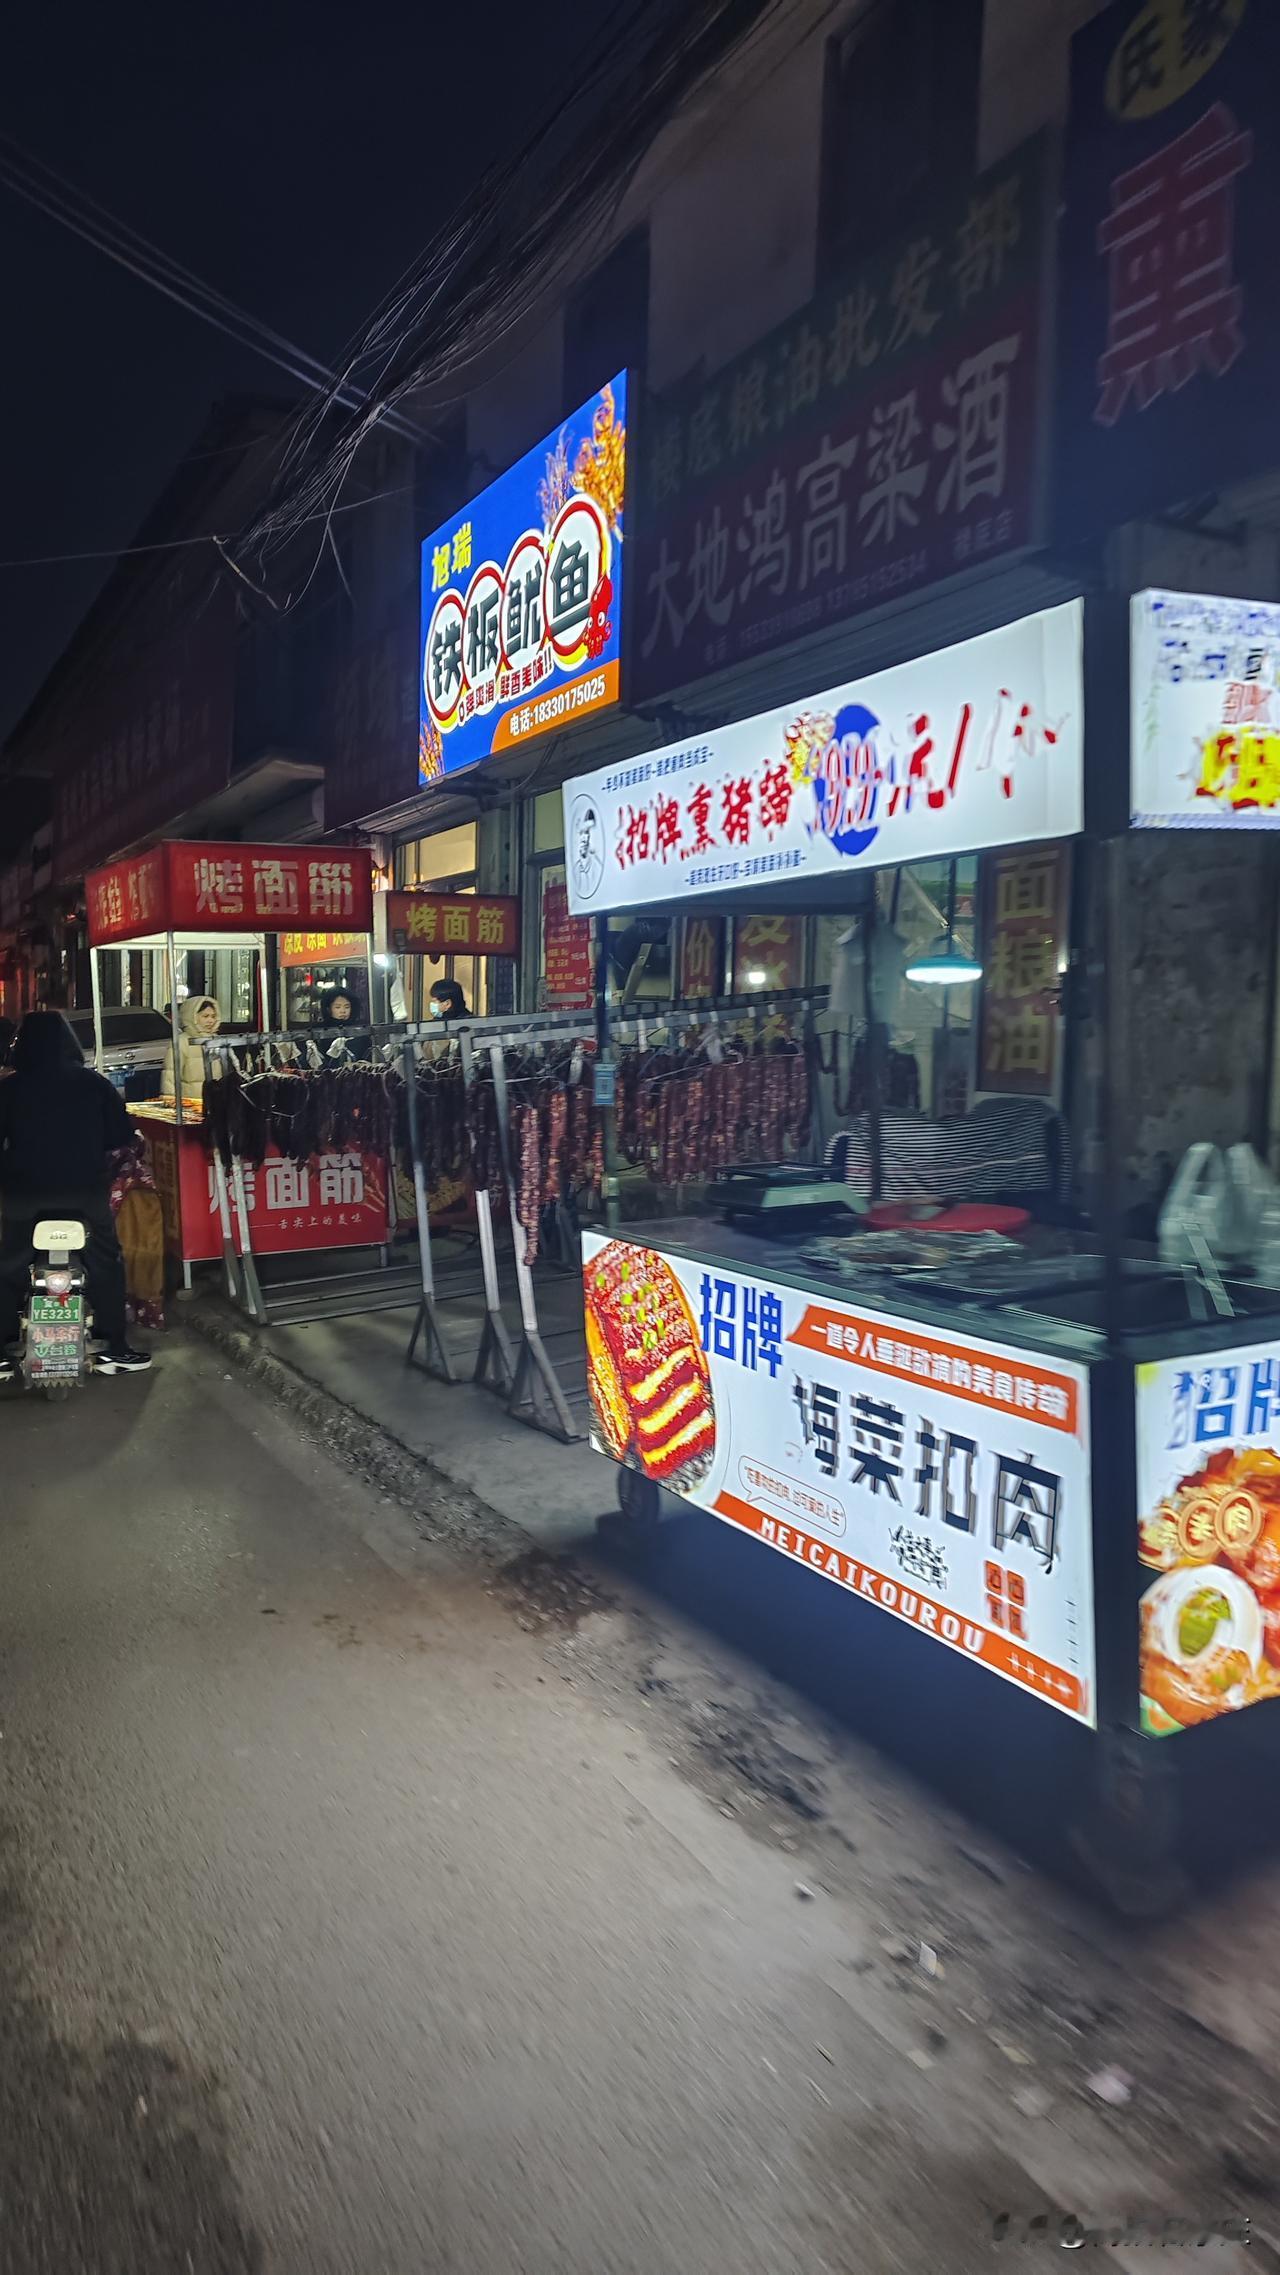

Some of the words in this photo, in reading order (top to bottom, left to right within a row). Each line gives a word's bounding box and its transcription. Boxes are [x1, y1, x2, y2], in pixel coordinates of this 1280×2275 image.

[642, 333, 1019, 660] 大地鸿高粱酒
[430, 521, 473, 593] 旭瑞
[431, 539, 590, 701] 铁板鱿鱼
[510, 674, 605, 736] 电话:18330175025
[194, 858, 353, 915] 烤面筋
[407, 903, 504, 944] 烤面筋
[208, 1153, 364, 1213] 烤面筋
[34, 1309, 79, 1320] YE3231
[700, 1273, 783, 1377] 招牌
[792, 1368, 1063, 1574] 梅菜扣肉
[756, 1516, 987, 1654] MEICAIKOUROU
